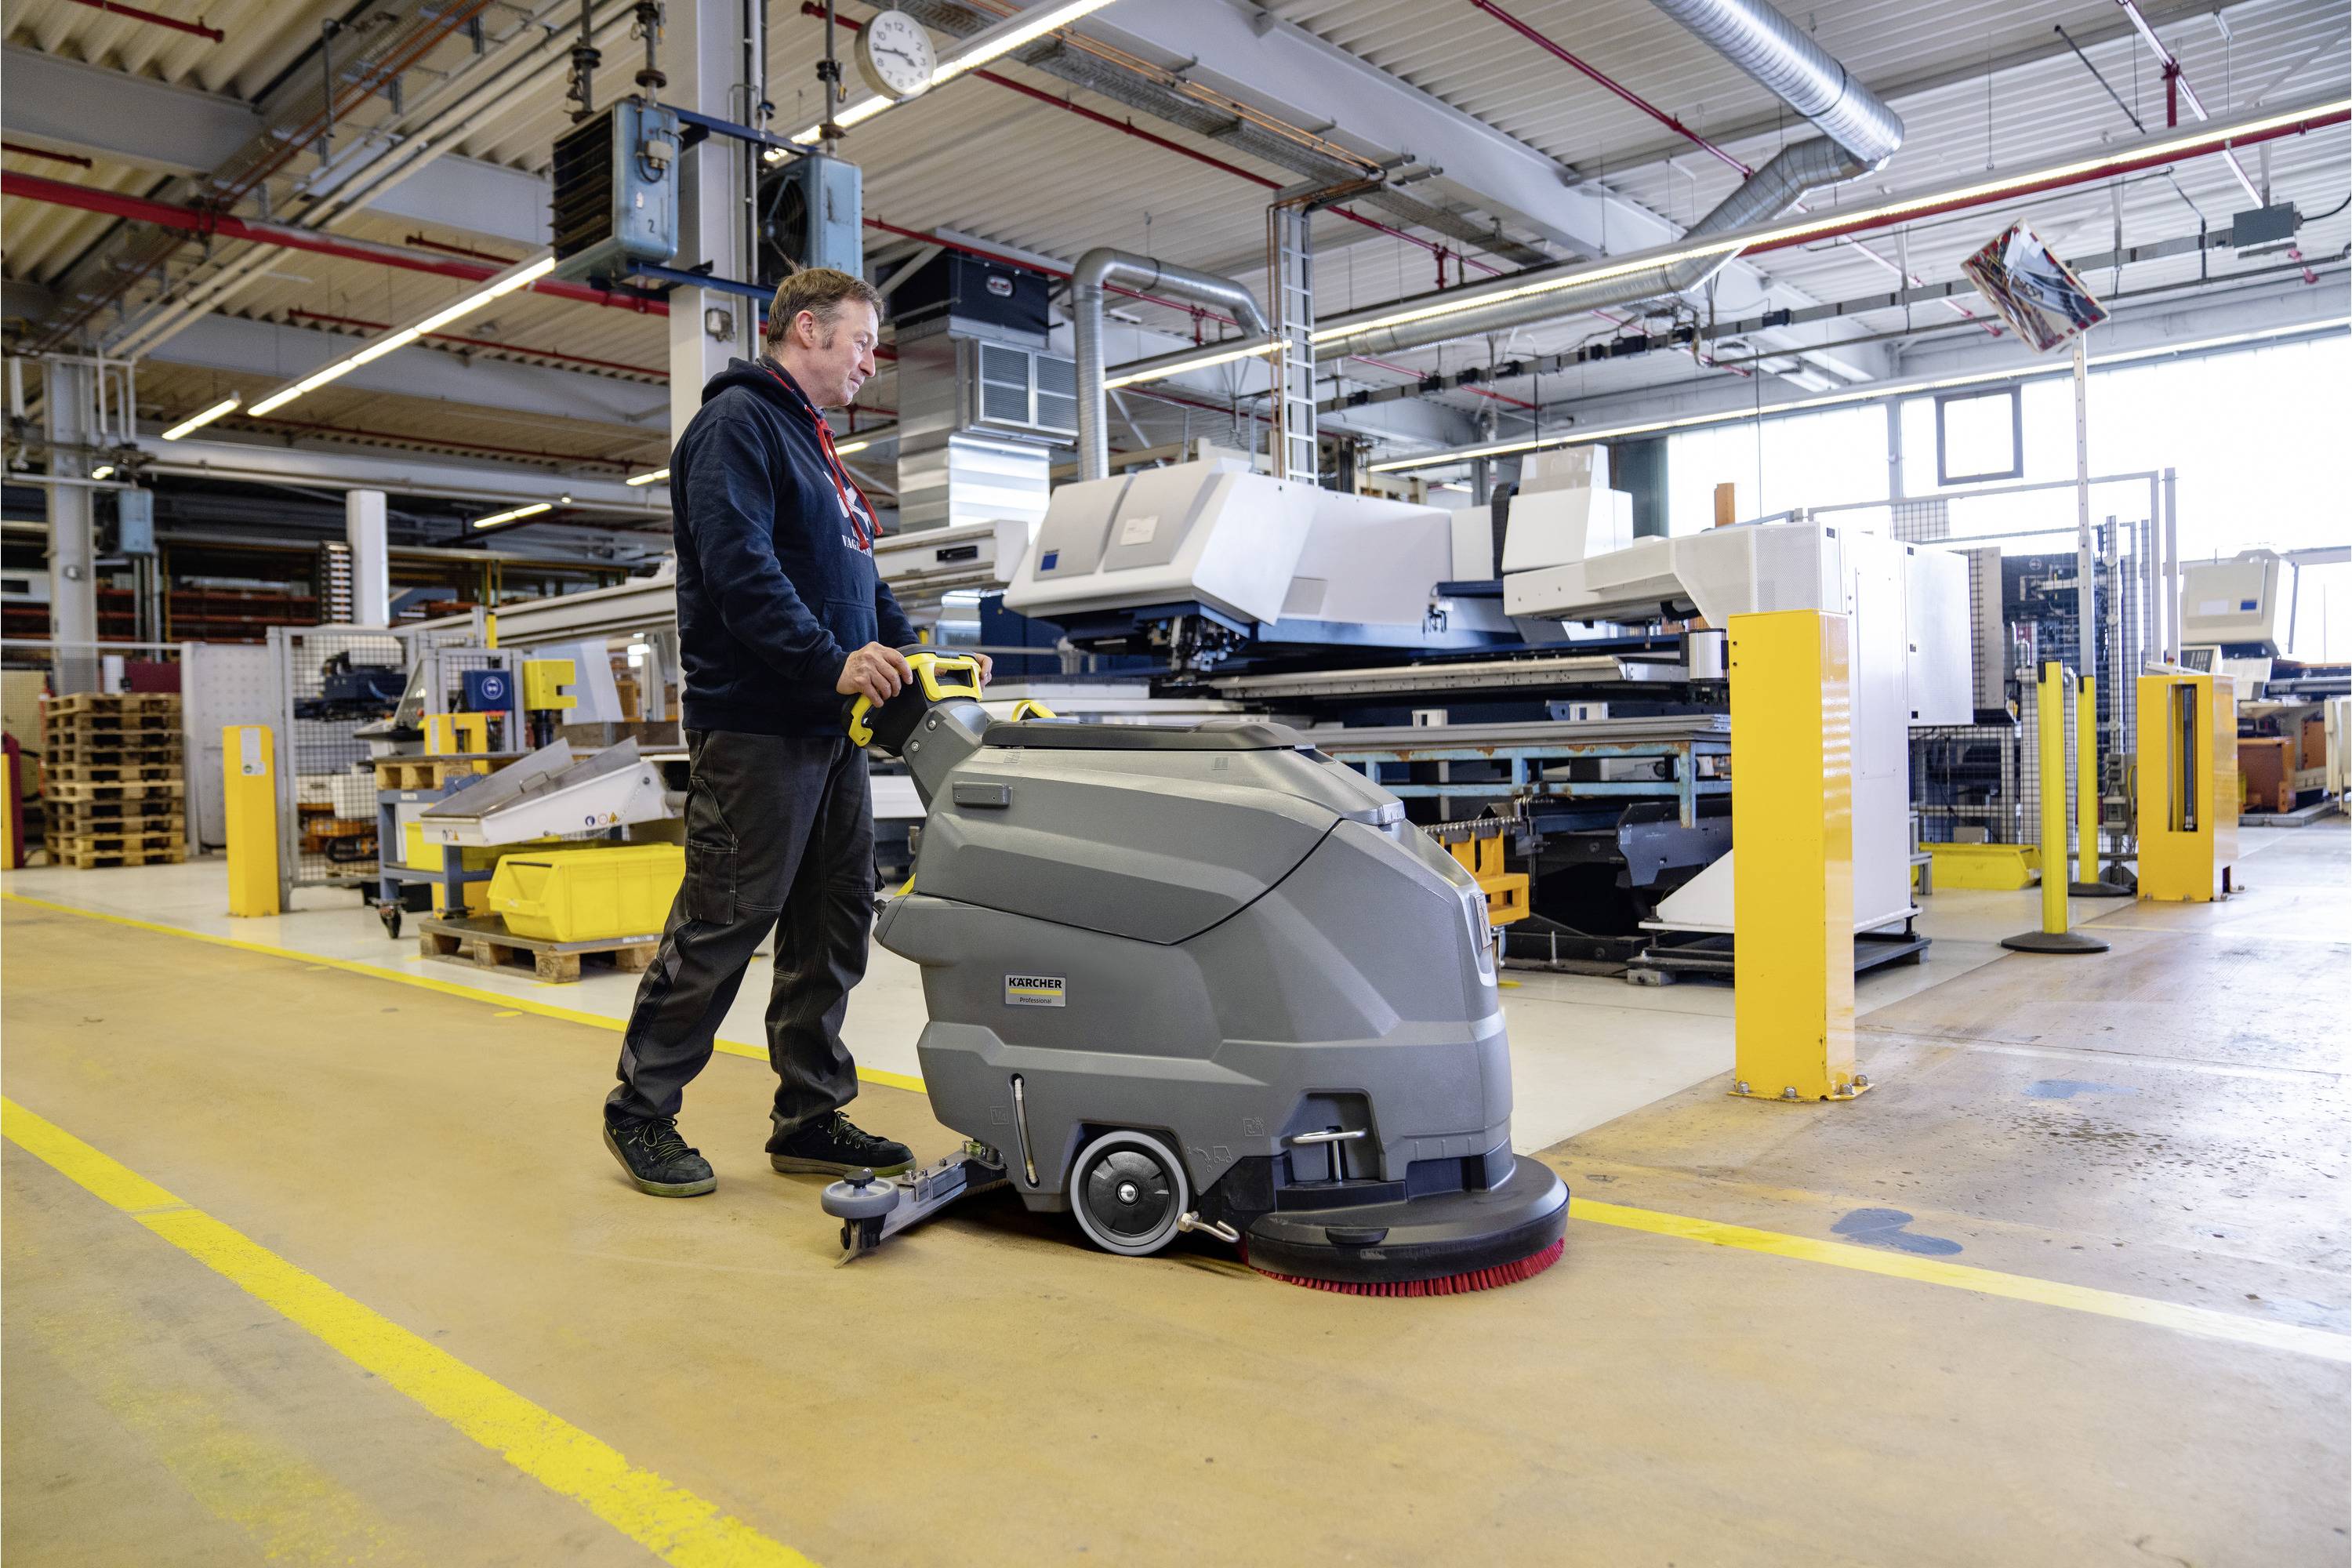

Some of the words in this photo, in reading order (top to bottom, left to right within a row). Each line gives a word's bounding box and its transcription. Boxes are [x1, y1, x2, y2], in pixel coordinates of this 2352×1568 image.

[894, 22, 904, 32] 12
[877, 31, 886, 41] 10
[916, 42, 923, 52] 2
[877, 57, 884, 67] 8
[920, 57, 926, 66] 3
[886, 70, 892, 79] 7
[897, 78, 904, 87] 6
[648, 219, 655, 234] 2
[1008, 978, 1062, 989] KÄRCHER
